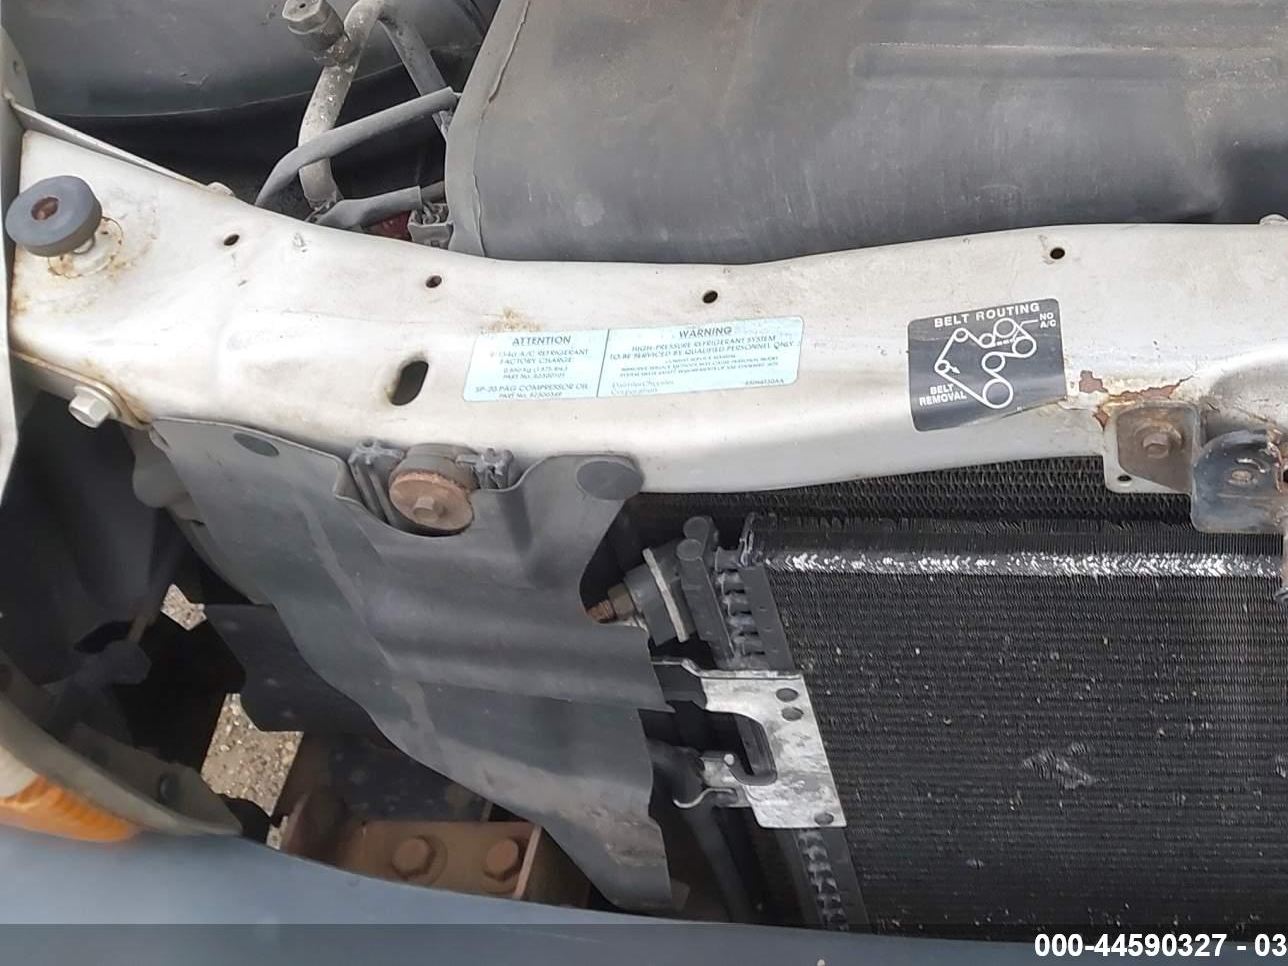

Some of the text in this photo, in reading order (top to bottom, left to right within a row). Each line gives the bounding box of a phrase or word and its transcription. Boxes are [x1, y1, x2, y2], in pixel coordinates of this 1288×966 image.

[934, 302, 1040, 328] BELT ROUTING
[1039, 312, 1054, 321] NO
[1040, 319, 1057, 329] A/C
[679, 326, 733, 339] WARNING
[511, 335, 572, 347] ATTENTION
[929, 383, 955, 395] BELT
[919, 390, 968, 407] REMOVAL
